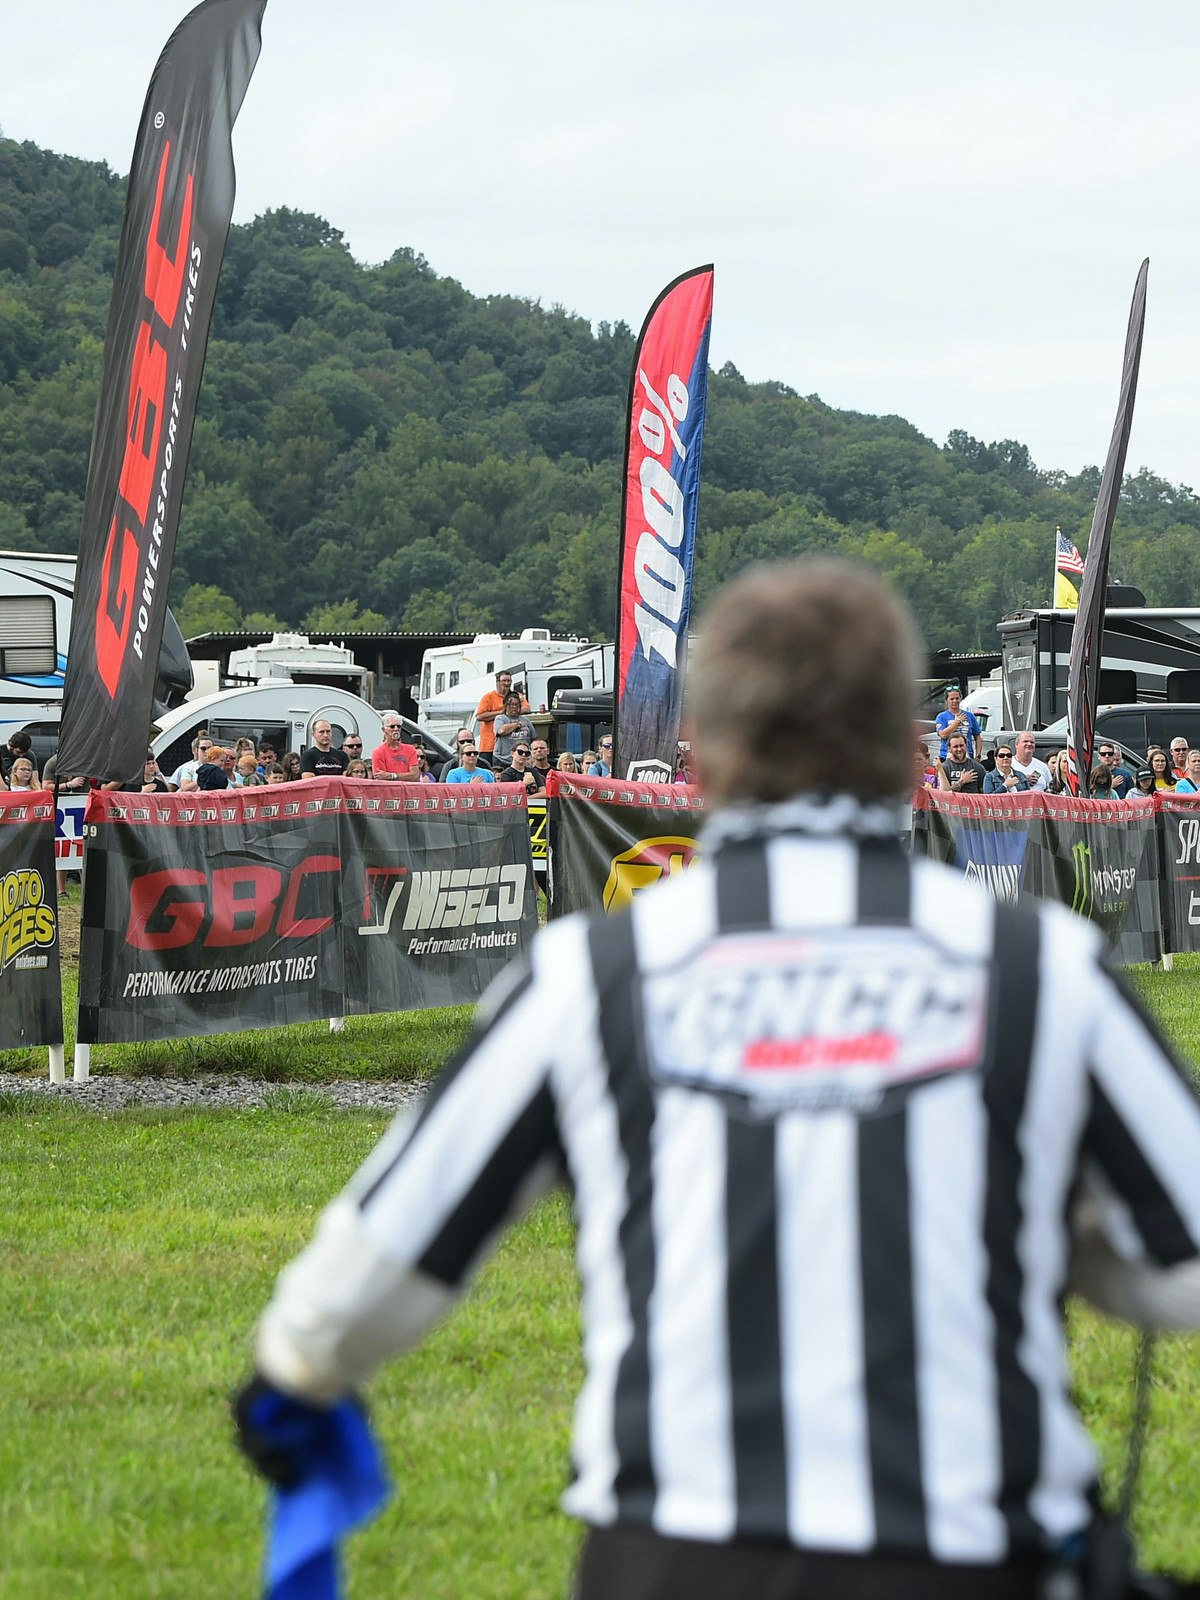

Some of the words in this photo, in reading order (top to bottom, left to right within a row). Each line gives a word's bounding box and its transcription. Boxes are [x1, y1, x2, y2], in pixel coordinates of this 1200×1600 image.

[95, 139, 194, 700] GBC
[133, 372, 182, 660] POWERSPORTS
[633, 368, 689, 669] 100%
[0, 870, 42, 920] OTO
[125, 855, 342, 951] GBC
[402, 863, 527, 931] WISECO
[1093, 865, 1136, 897] MONSTER
[123, 968, 209, 998] PERFORMANCE
[206, 959, 282, 993] MOTORSPORTS
[284, 955, 318, 983] TIRES
[407, 936, 469, 955] Performance
[469, 931, 518, 950] Products
